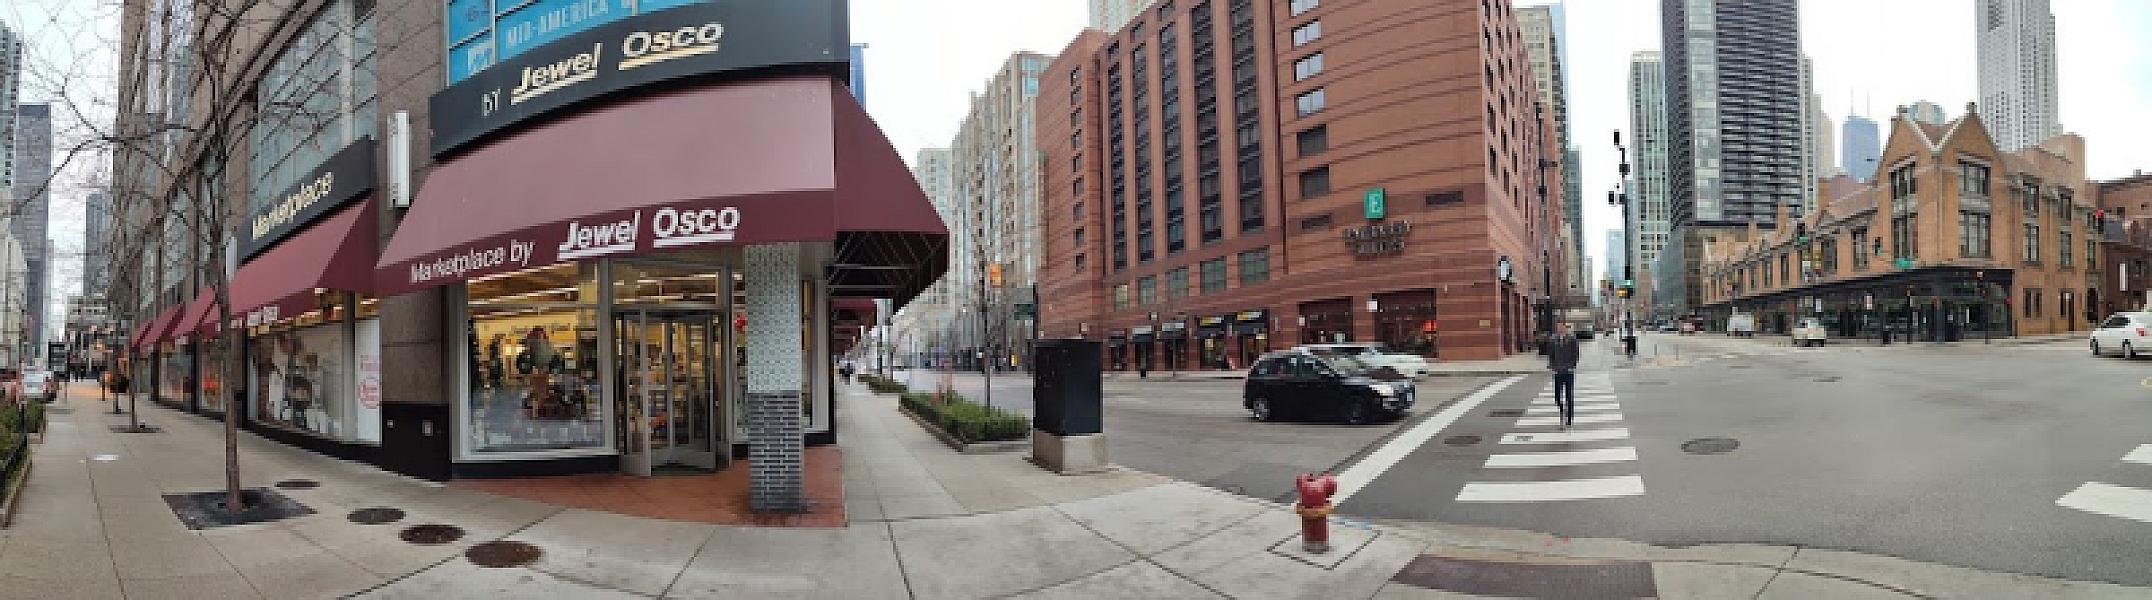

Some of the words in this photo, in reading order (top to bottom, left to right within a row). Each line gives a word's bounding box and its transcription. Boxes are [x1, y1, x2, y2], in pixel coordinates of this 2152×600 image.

[511, 42, 603, 97] Jewel
[620, 22, 725, 60] Osco
[252, 171, 334, 240] Marketplace
[410, 246, 505, 283] Marketplace
[510, 239, 536, 266] by
[557, 209, 641, 254] Jewel
[653, 206, 741, 240] Osco
